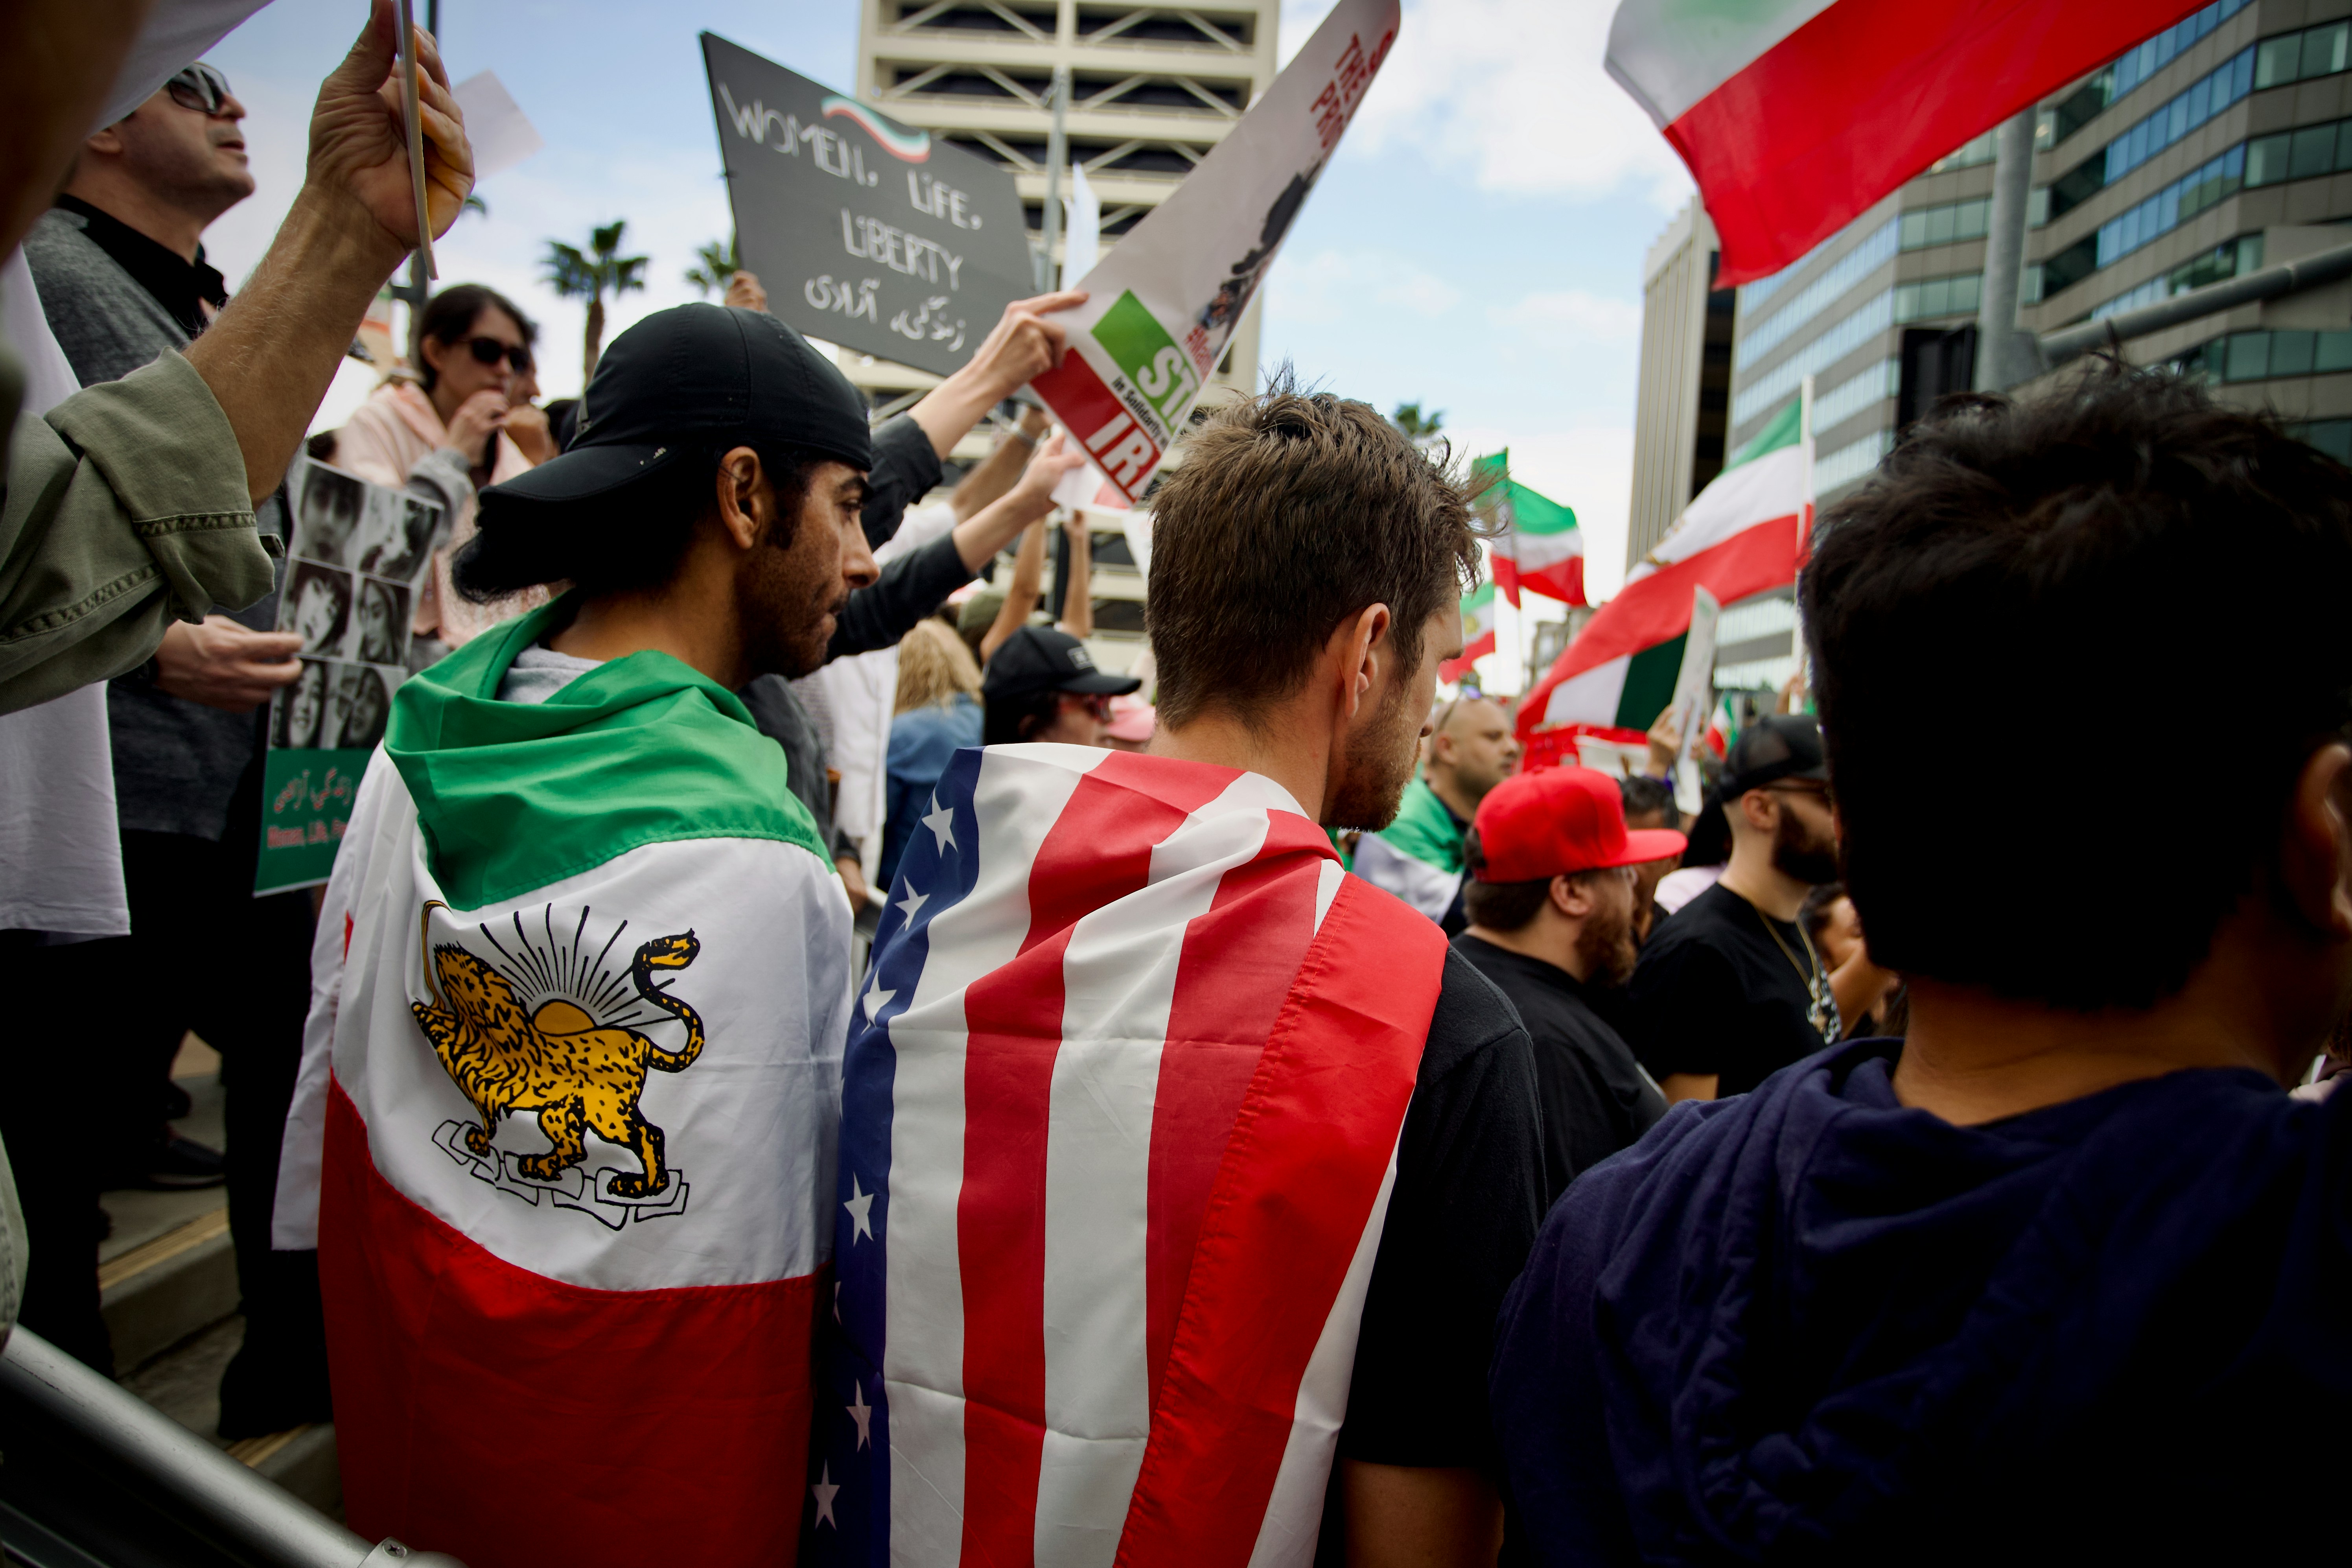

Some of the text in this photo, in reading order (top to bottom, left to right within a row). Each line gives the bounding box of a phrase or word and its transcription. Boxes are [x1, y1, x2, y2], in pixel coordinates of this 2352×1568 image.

[1334, 31, 1367, 104] THE
[1112, 376, 1161, 439] in Solidarity
